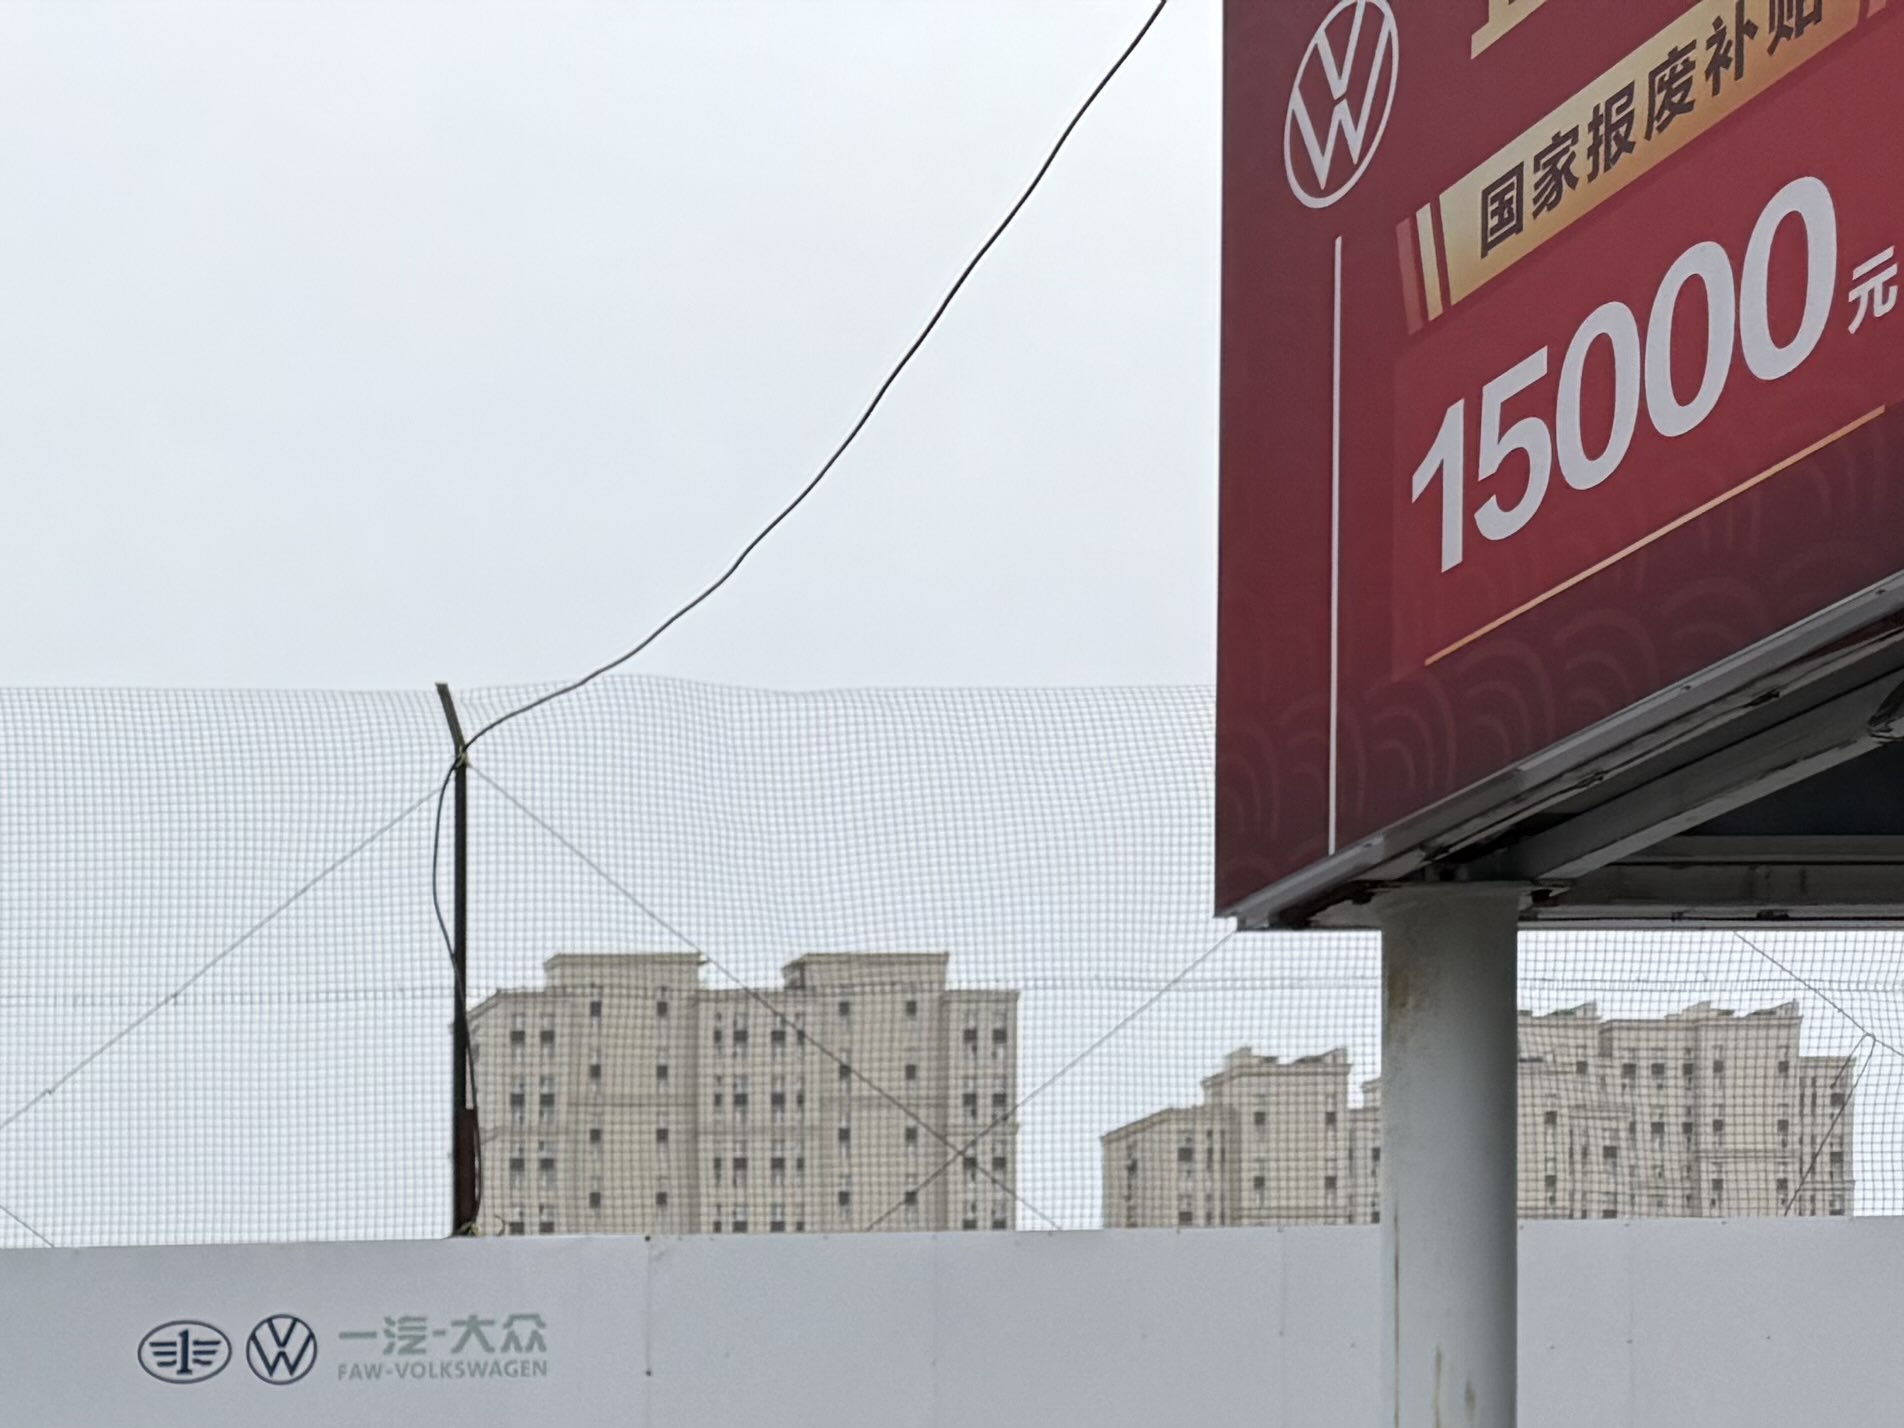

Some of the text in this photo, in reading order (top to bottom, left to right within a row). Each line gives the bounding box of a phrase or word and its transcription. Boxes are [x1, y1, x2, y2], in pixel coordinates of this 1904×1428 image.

[1480, 0, 1824, 260] 国家报废补贴
[338, 1313, 548, 1356] 一汽-大众
[338, 1360, 548, 1380] FAW-VOLKSWAGEN
